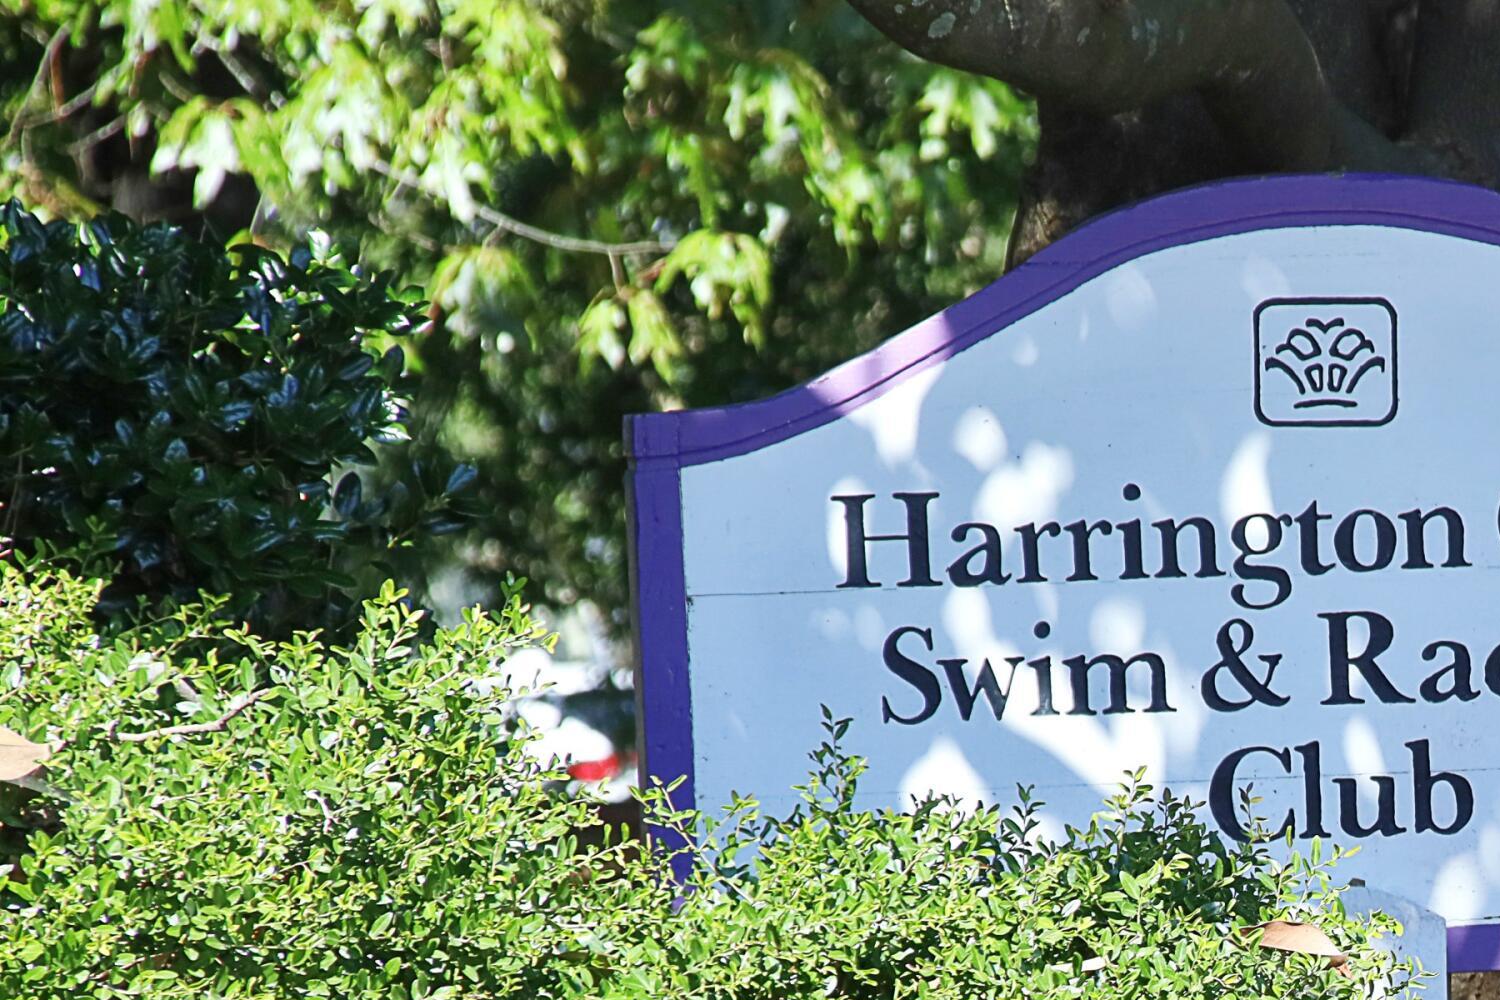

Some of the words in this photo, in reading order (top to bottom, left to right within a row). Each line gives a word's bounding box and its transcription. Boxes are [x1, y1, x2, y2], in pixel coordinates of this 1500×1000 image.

[830, 483, 1473, 611] Harrington
[882, 621, 1177, 725] Swim
[1201, 618, 1291, 713] &
[1208, 738, 1474, 844] Club
